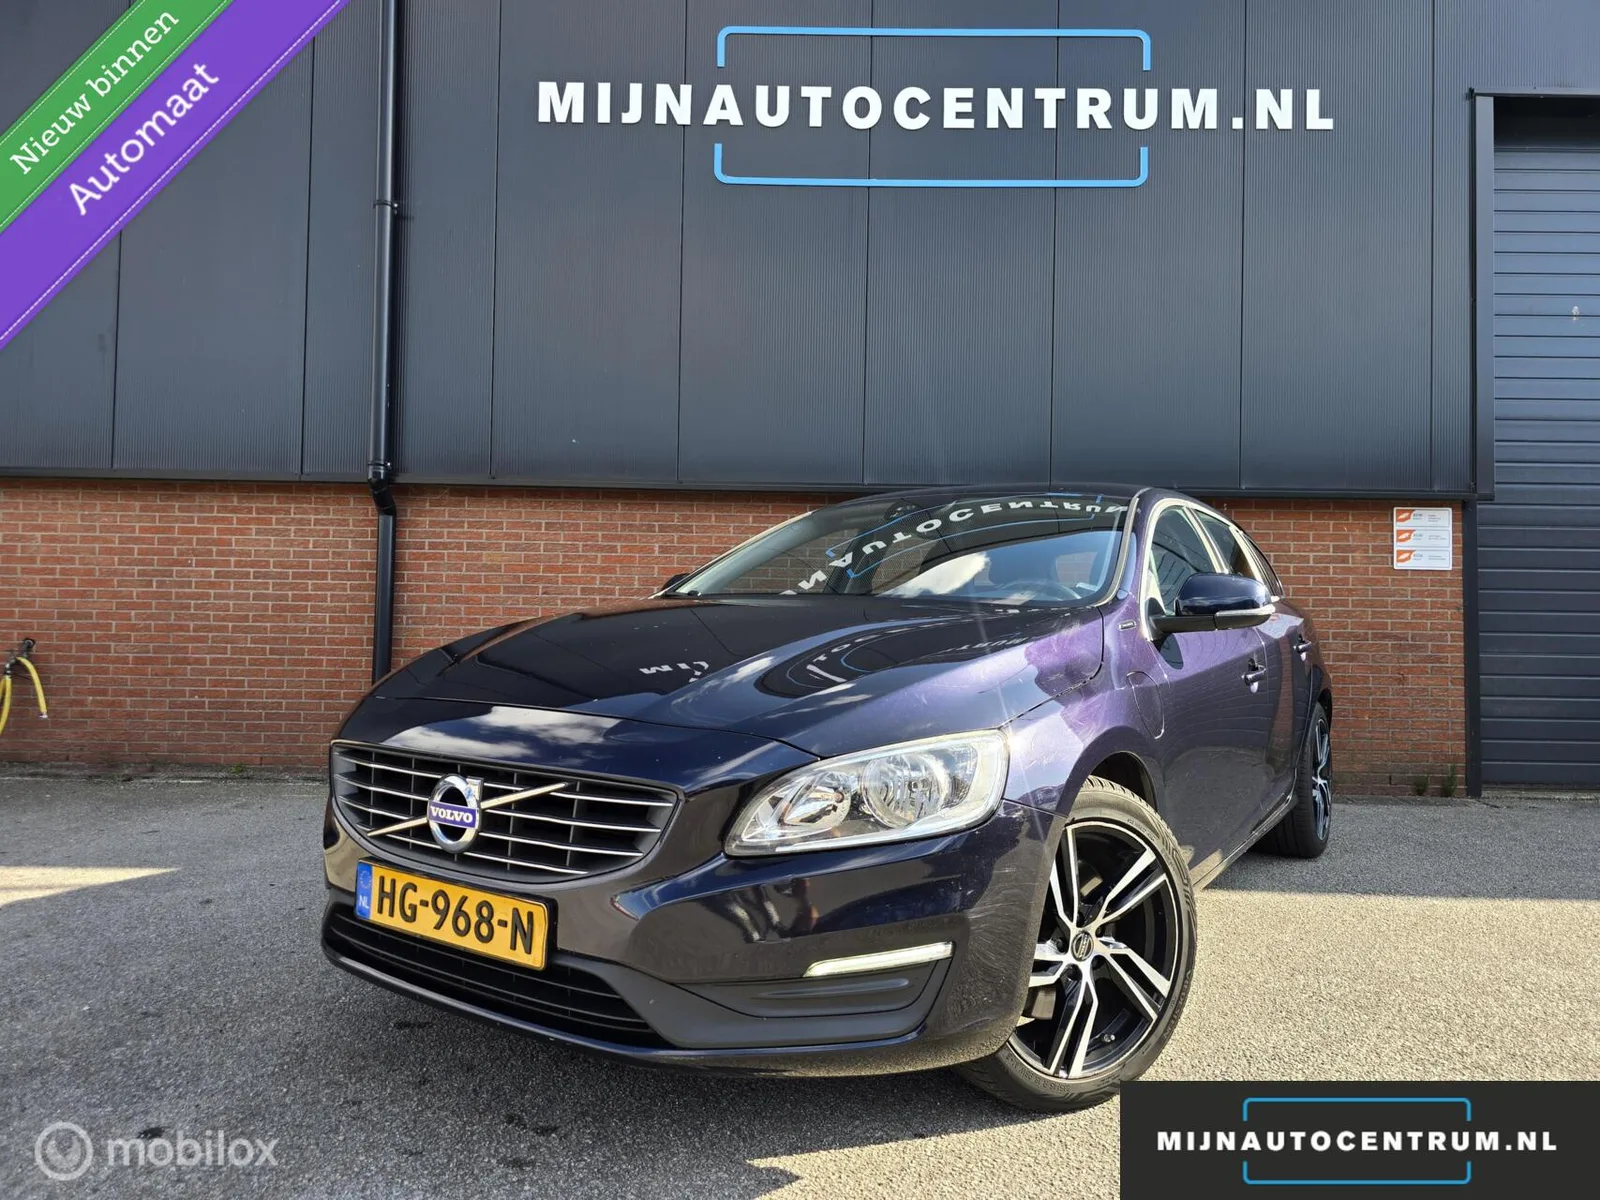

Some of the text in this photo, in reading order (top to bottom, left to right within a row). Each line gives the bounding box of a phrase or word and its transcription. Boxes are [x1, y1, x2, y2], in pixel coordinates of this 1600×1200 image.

[537, 80, 1335, 131] MIJNAUTOCENTRUM.NL
[429, 805, 475, 825] VOLVO
[376, 874, 535, 956] HG-968-N
